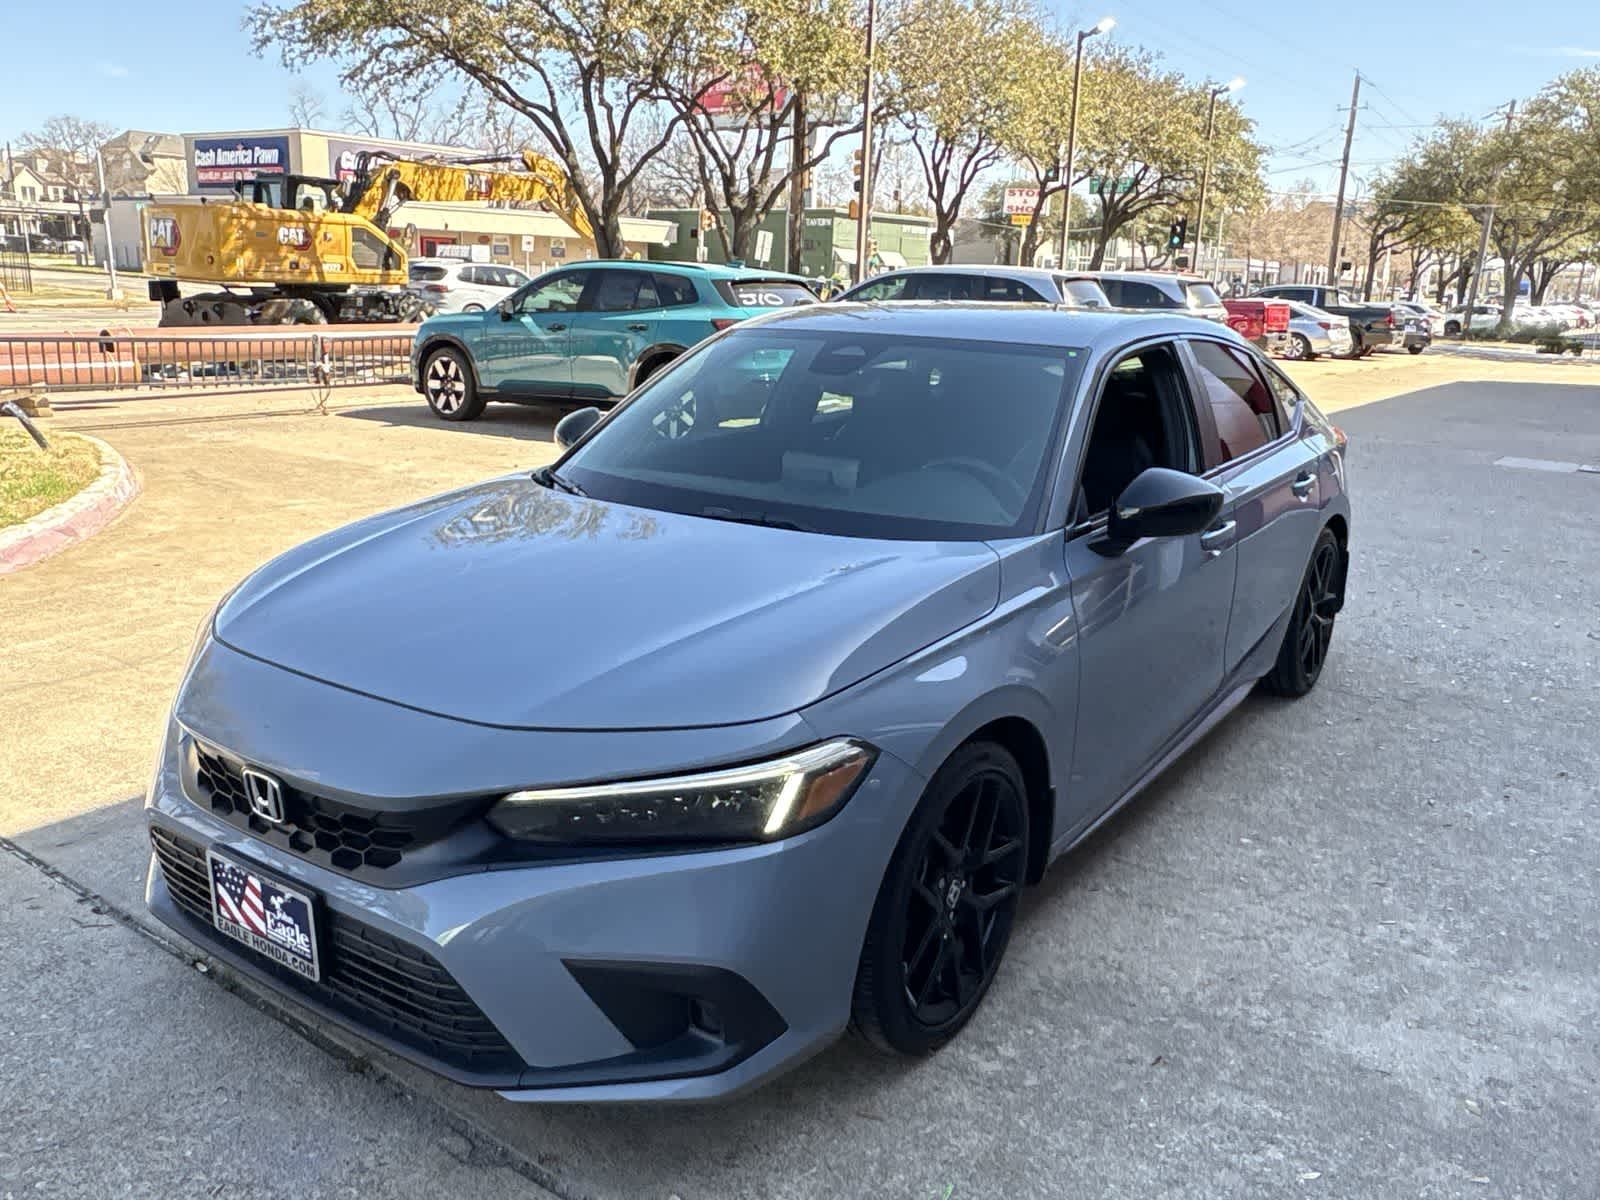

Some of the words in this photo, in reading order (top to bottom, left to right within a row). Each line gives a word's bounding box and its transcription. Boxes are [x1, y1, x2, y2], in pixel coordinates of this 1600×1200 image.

[195, 149, 216, 167] Cash
[216, 147, 252, 166] America
[254, 146, 279, 164] Pawn
[151, 218, 173, 249] CAT
[278, 227, 305, 246] CAT
[265, 909, 310, 948] Eagle
[217, 917, 250, 944] EAGLE
[252, 934, 316, 979] HONDA.COM
